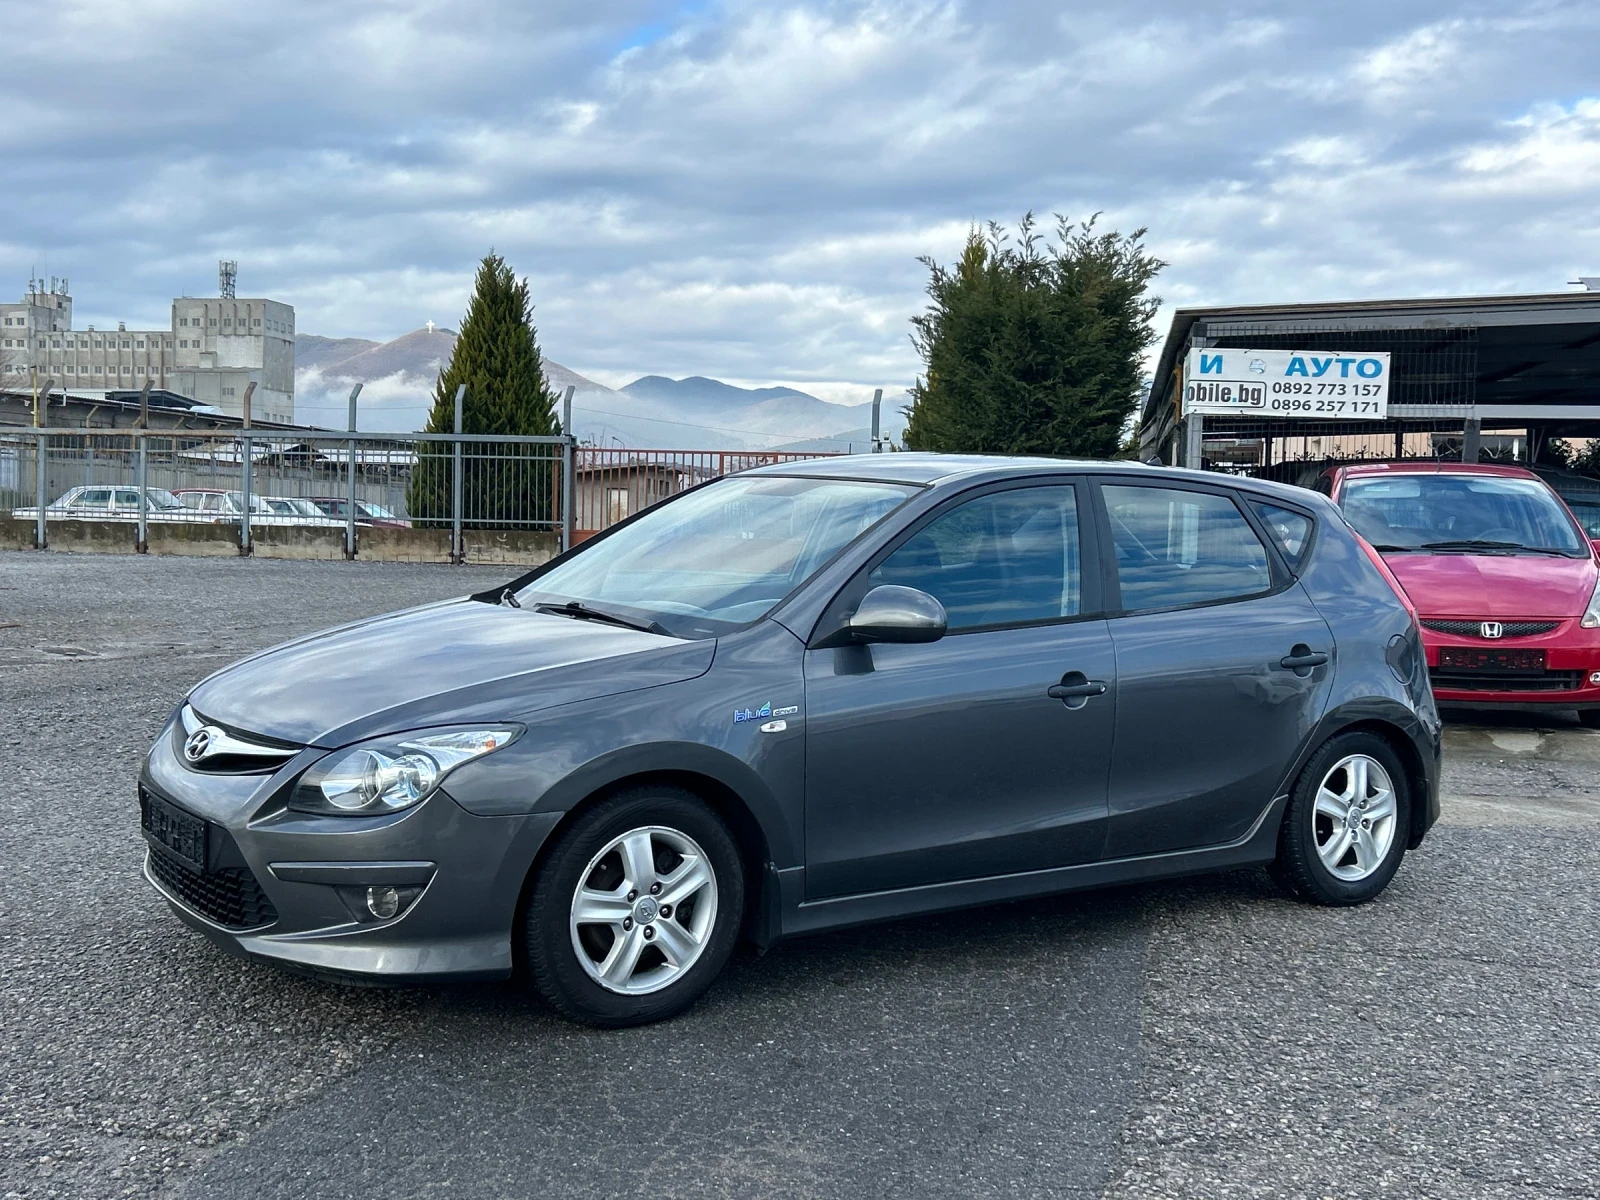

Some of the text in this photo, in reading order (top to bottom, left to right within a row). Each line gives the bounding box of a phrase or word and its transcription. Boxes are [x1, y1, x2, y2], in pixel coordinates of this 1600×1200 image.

[1200, 354, 1383, 379] И АУТО
[1272, 382, 1382, 397] 0892 773 157
[1271, 399, 1379, 413] 0896 257 171
[734, 706, 771, 723] blue
